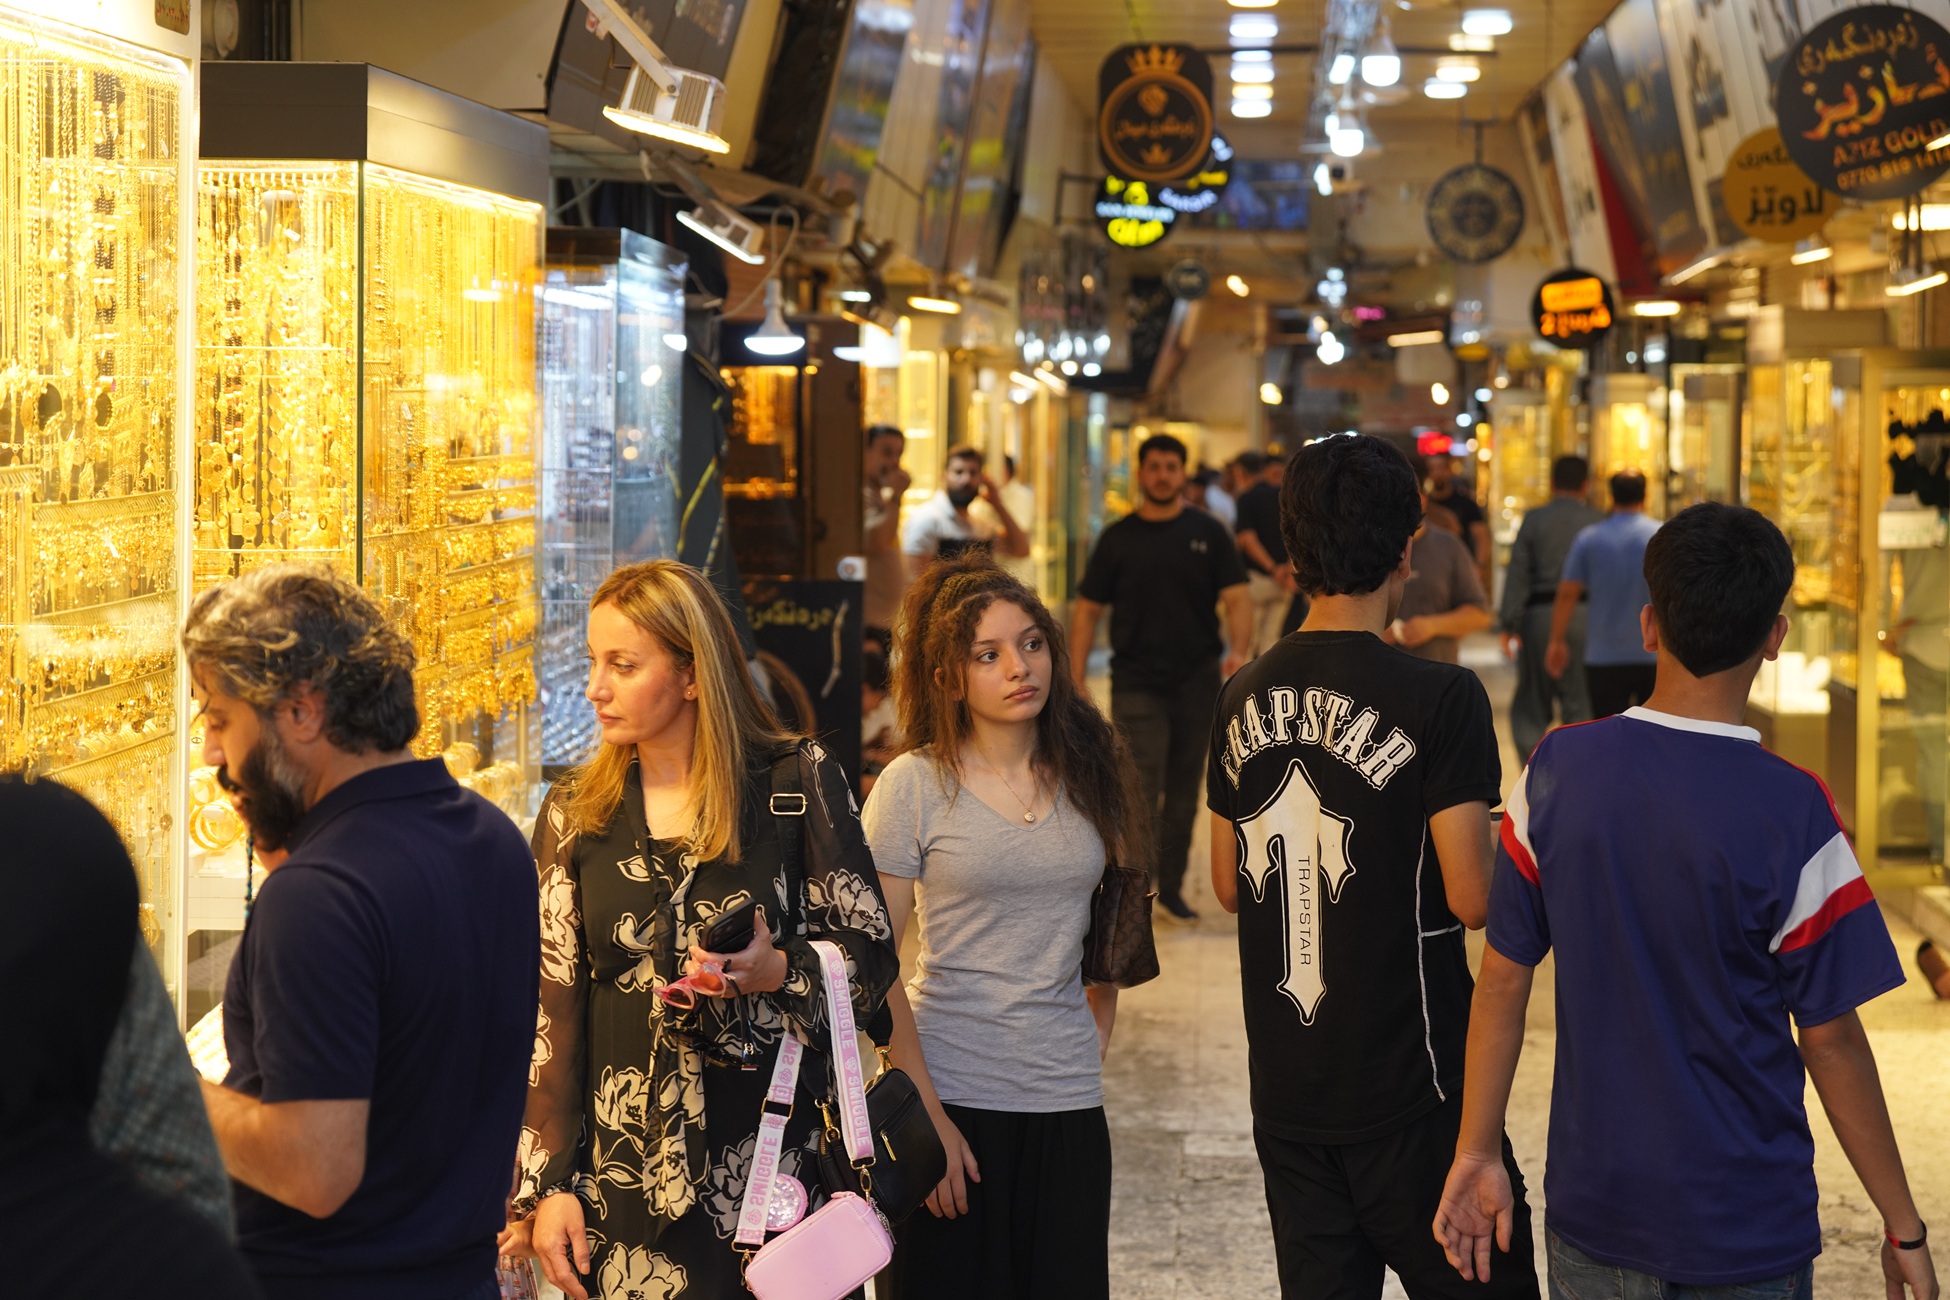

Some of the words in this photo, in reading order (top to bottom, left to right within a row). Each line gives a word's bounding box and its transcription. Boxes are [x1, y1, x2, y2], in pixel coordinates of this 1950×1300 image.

[1298, 855, 1311, 965] TRAPSTAR
[832, 978, 855, 1050] SMIGGLE
[847, 1075, 871, 1147] SMIGGLE
